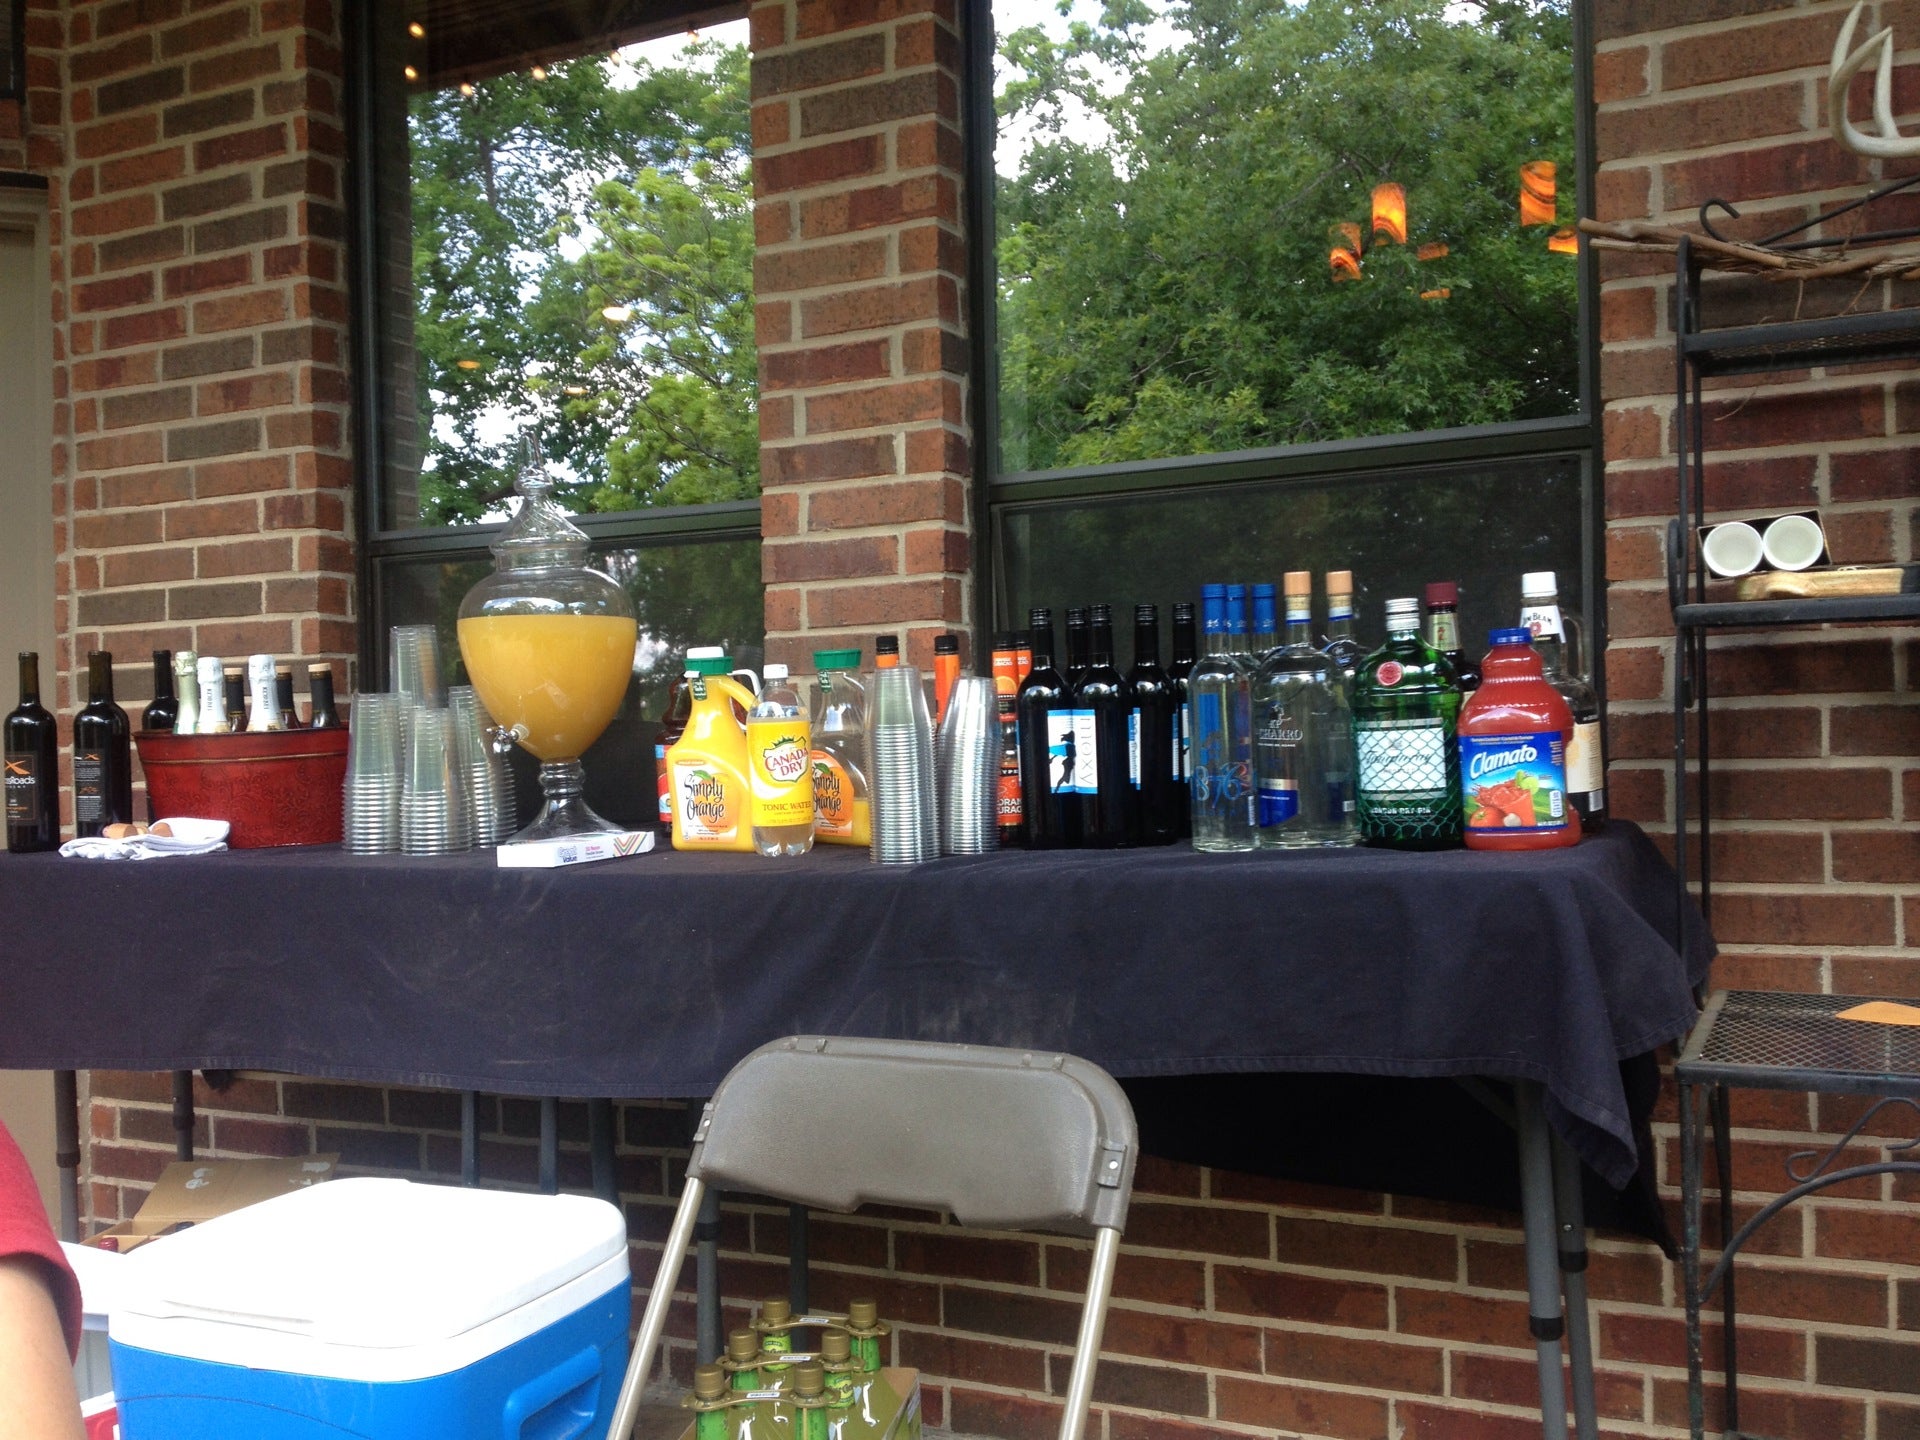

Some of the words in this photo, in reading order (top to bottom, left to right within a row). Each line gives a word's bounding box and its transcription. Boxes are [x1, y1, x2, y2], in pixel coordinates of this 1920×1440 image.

[765, 748, 808, 772] CANADA
[780, 760, 803, 776] DRY
[1470, 744, 1538, 780] Clamato
[684, 773, 723, 803] Simply
[687, 799, 725, 824] Orange
[762, 803, 789, 811] TONIC
